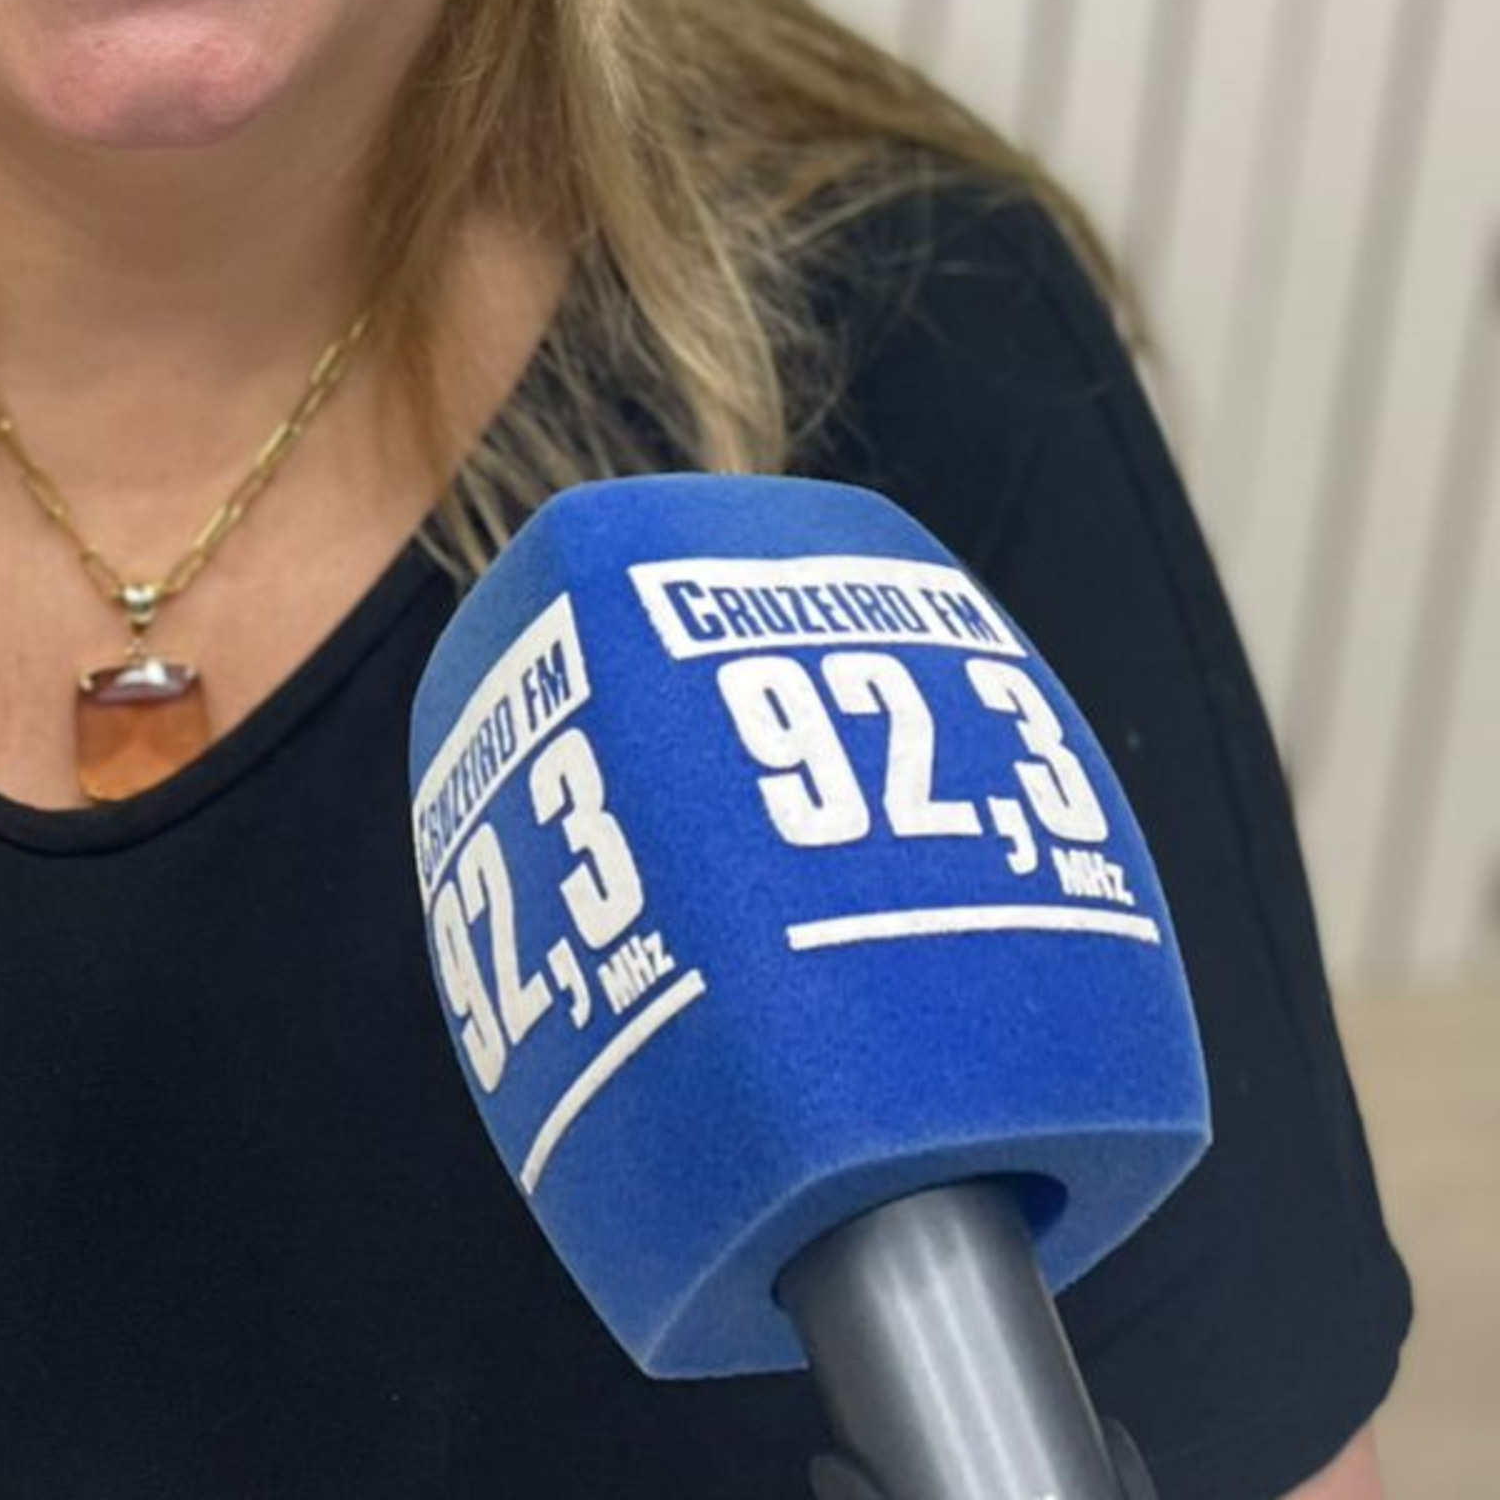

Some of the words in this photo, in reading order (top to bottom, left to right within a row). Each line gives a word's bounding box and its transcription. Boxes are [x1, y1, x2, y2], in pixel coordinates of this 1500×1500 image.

[662, 579, 931, 642] CRUZEIRO
[920, 588, 1004, 645] FM
[521, 638, 572, 732] FM
[717, 651, 1109, 875] 92,3
[432, 728, 645, 1093] 92,3
[1050, 846, 1136, 906] MHz
[598, 931, 676, 1015] MHz
